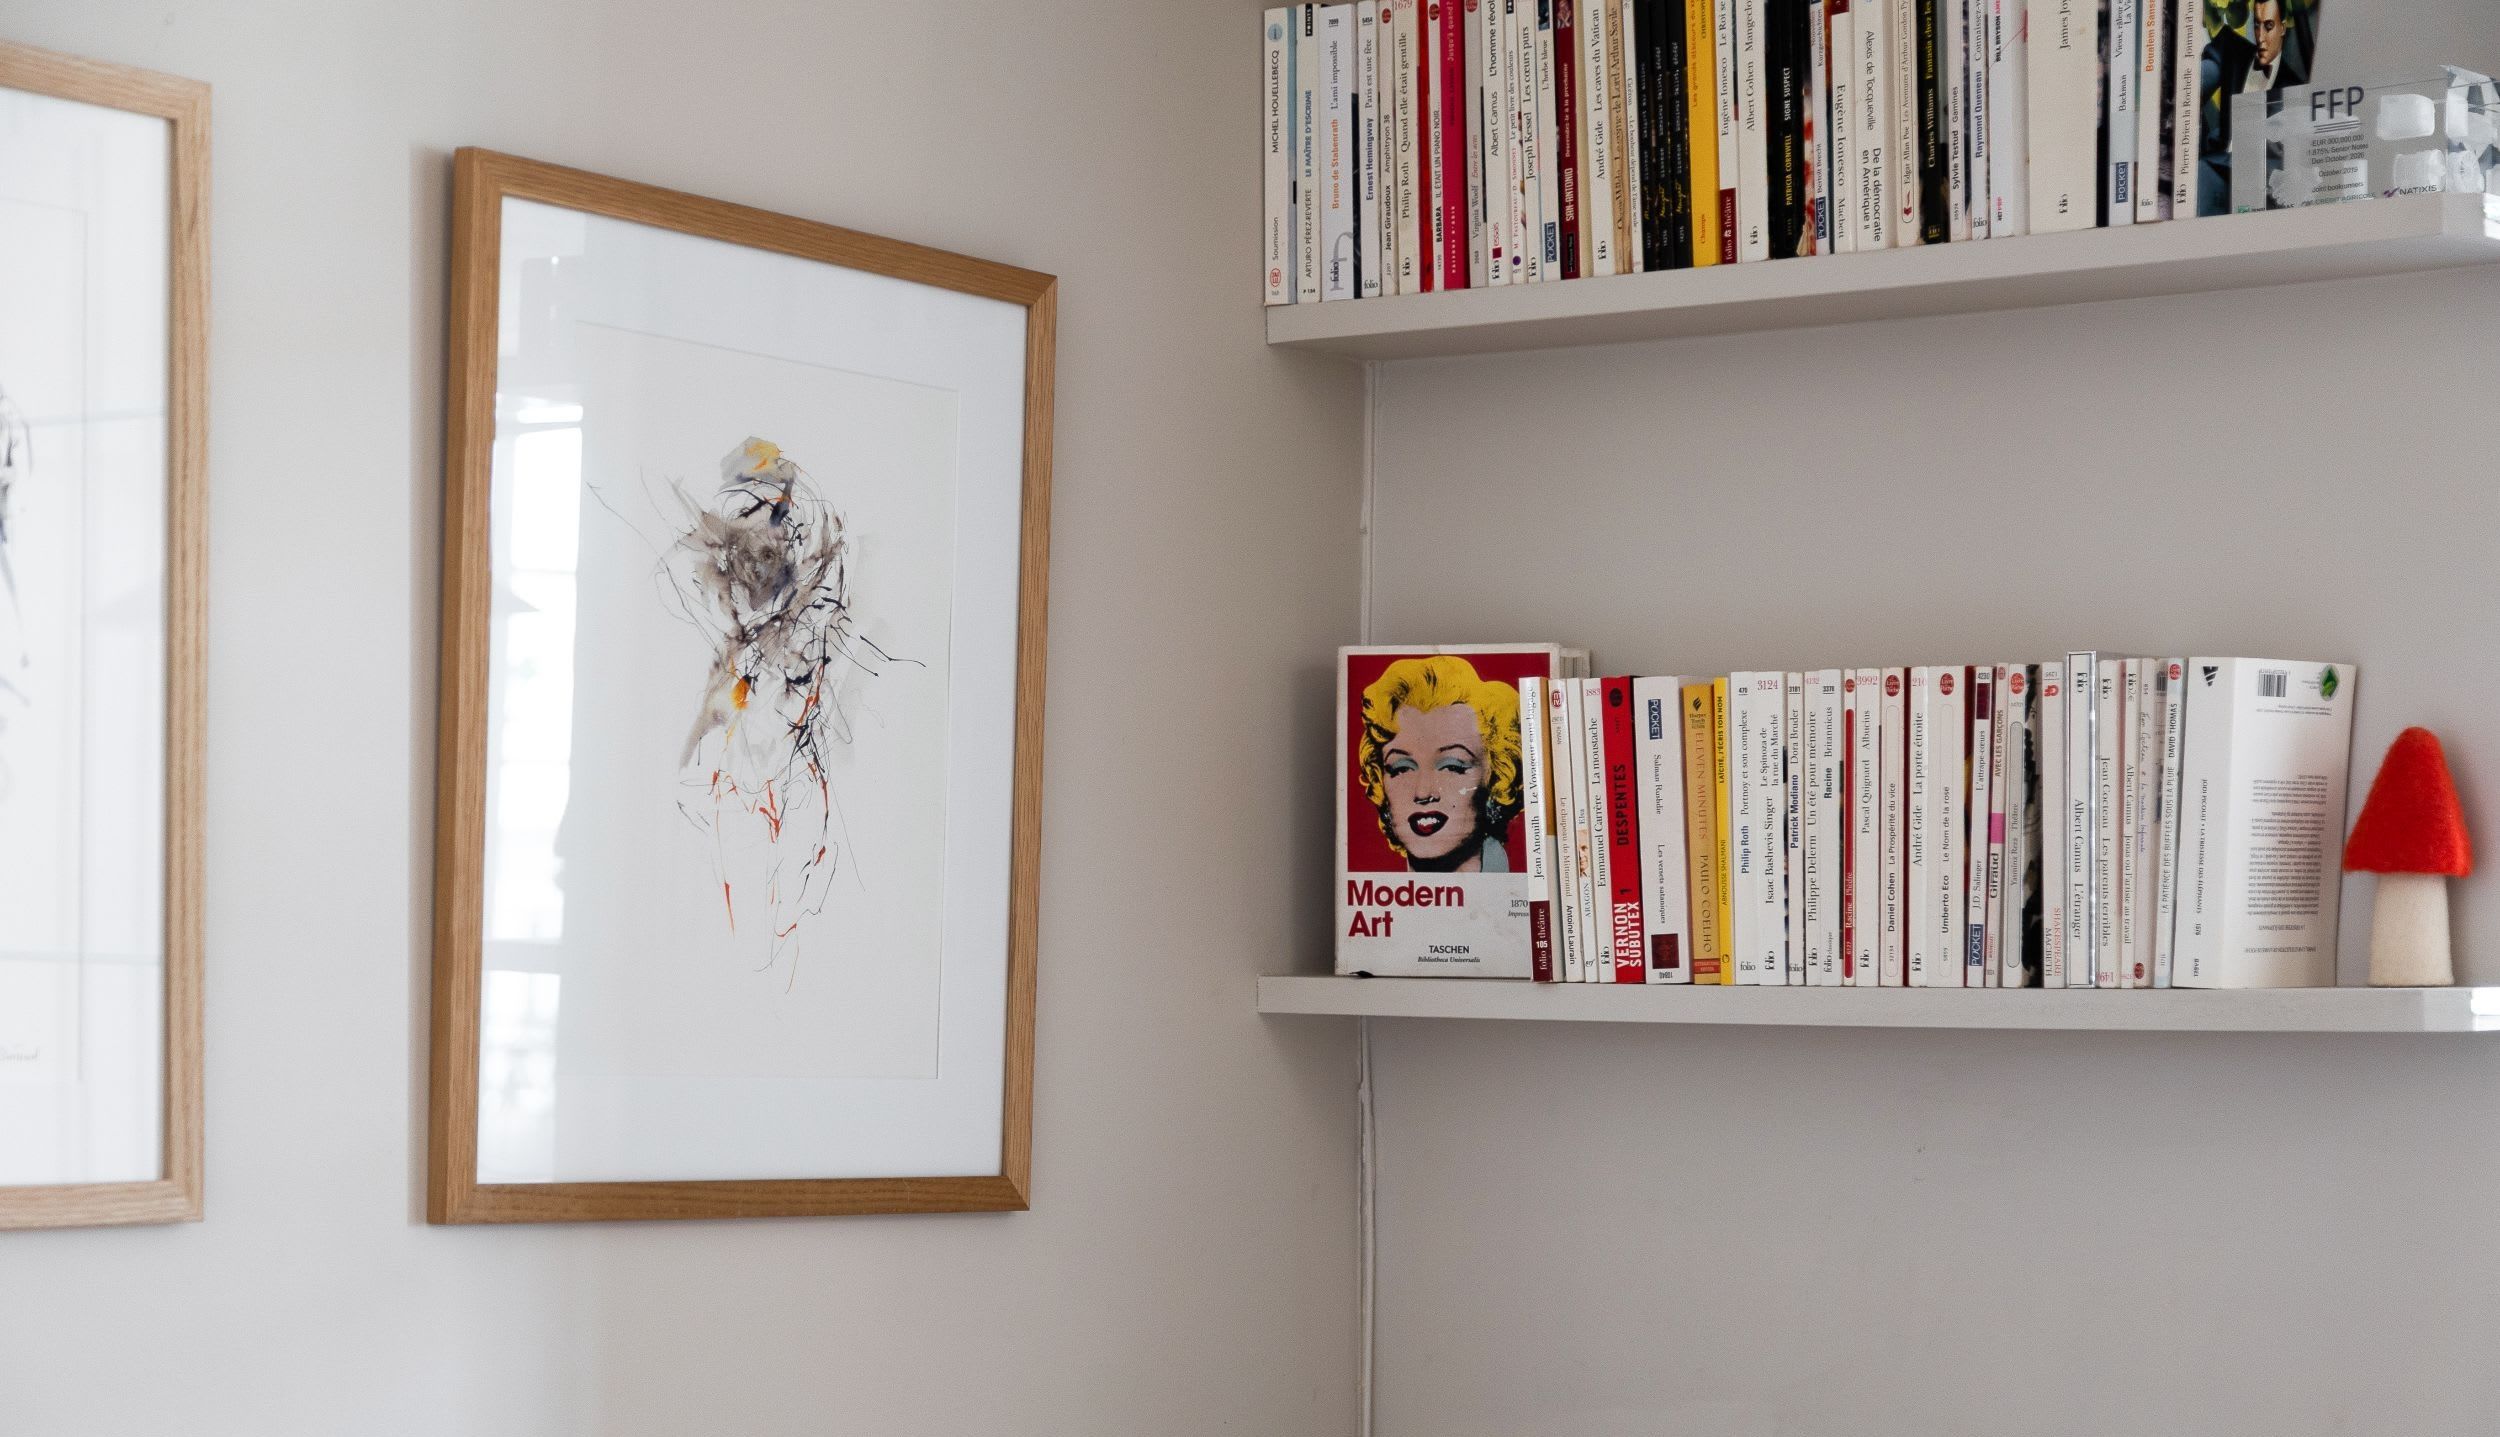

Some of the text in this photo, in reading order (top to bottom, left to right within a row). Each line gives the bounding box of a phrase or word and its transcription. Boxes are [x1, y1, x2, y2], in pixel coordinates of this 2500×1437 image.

[2184, 0, 2194, 59] Journal d'un
[1591, 9, 1603, 111] Les caves du Vatican
[1865, 30, 1875, 131] Alexis de Tocqueville
[1272, 50, 1280, 153] MICHEL HOUELLEBECQ
[1398, 32, 1409, 153] Quand elle était gentille
[1720, 57, 1731, 136] Eugène Ionesco
[1745, 61, 1755, 132] Albert Cohen
[1951, 86, 1959, 123] Gamines
[1974, 71, 1984, 158] Raymond Queneau
[2180, 68, 2193, 174] Pierre Drieu la Rochelle
[2311, 86, 2365, 122] FFP
[1490, 91, 1499, 157] Albert Camus
[1523, 112, 1537, 181] Joseph Kessel
[1594, 120, 1605, 180] André Gide
[1784, 134, 1793, 172] CORNWELL
[1835, 84, 1846, 186] Eugène Ionesco
[1902, 142, 1911, 162] Allan
[1925, 88, 1936, 168] Charles Williams
[1365, 118, 1375, 200] Ernest Hemingway
[1903, 163, 1912, 184] Edgar
[1951, 130, 1961, 190] Sylvie Testud
[2118, 162, 2127, 200] POCKET
[2318, 168, 2342, 178] October
[2325, 154, 2349, 164] October
[2350, 152, 2365, 160] 2026
[1384, 185, 1392, 250] Jean Giraudoux
[1401, 162, 1410, 219] Philip Roth
[1471, 185, 1481, 238] Virginia Woolf
[1564, 167, 1574, 221] SAN-ANTONIO
[1785, 174, 1793, 206] PATRICIA
[1816, 197, 1826, 238] POCKET
[2399, 185, 2437, 195] NATIXIS
[1272, 217, 1280, 261] Soumission
[1435, 206, 1443, 242] BARBARA
[1545, 222, 1556, 262] POCKET
[1757, 679, 1779, 691] 3124
[1649, 698, 1662, 740] POCKET
[1789, 709, 1799, 765] Dora Bruder
[1860, 710, 1871, 750] Albucius
[1994, 709, 2006, 777] AVEC LES GARÇONS
[2167, 703, 2178, 759] DAVID THOMAS
[1588, 718, 1600, 784] La moustache
[1695, 732, 1706, 780] ELEVEN
[1738, 710, 1751, 815] Portnoy et son complexe
[1759, 727, 1770, 787] Le Spinoza de
[1806, 711, 1819, 825] Un été pour mémoire
[1823, 706, 1833, 799] Racine Britannicus
[1912, 712, 1926, 795] La porte étroite
[1613, 764, 1630, 846] DESPENTES
[1697, 783, 1709, 840] MINUTES
[1790, 774, 1799, 849] Patrick Modiano
[1861, 759, 1873, 834] Pascal Quignard
[1941, 806, 1950, 815] la
[1941, 816, 1950, 828] de
[2099, 757, 2112, 829] Jean Cocteau
[2124, 764, 2135, 825] Albert Camus
[1530, 815, 1545, 879] Jean Anouilh
[1592, 795, 1607, 888] Emmanuel Carrère
[1740, 825, 1752, 874] Philip Roth
[1763, 796, 1776, 904] Isaac Bashevis Singer
[1885, 783, 1898, 932] Daniel Cohen La Prospérité du vice
[1912, 805, 1923, 867] André Gide
[1941, 829, 1950, 850] Nom
[1941, 852, 1950, 862] Le
[2073, 798, 2085, 873] Albert Camus
[1347, 880, 1465, 907] Modern
[1510, 899, 1529, 909] 1870
[1699, 855, 1712, 953] PAULO COELHO
[1806, 835, 1820, 922] Philippe Delerm
[1844, 872, 1854, 929] Racine Phèdre
[1941, 875, 1950, 891] Eco
[1972, 859, 1984, 910] J.D. Salinger
[1988, 852, 2000, 899] Giraud
[2099, 838, 2112, 947] Les parents terribles
[1348, 911, 1394, 938] Art
[1565, 905, 1576, 965] Antoine Laurain
[1614, 903, 1630, 968] VERNON
[1627, 901, 1642, 967] SUBUTEX
[1941, 893, 1950, 934] Umberto
[2071, 882, 2085, 940] L'étranger
[1417, 956, 1481, 964] Bibliotheca Universalis
[1429, 944, 1470, 954] TASCHEN
[1970, 924, 1982, 966] POCKET
[2053, 907, 2062, 977] SHAKESPEARE
